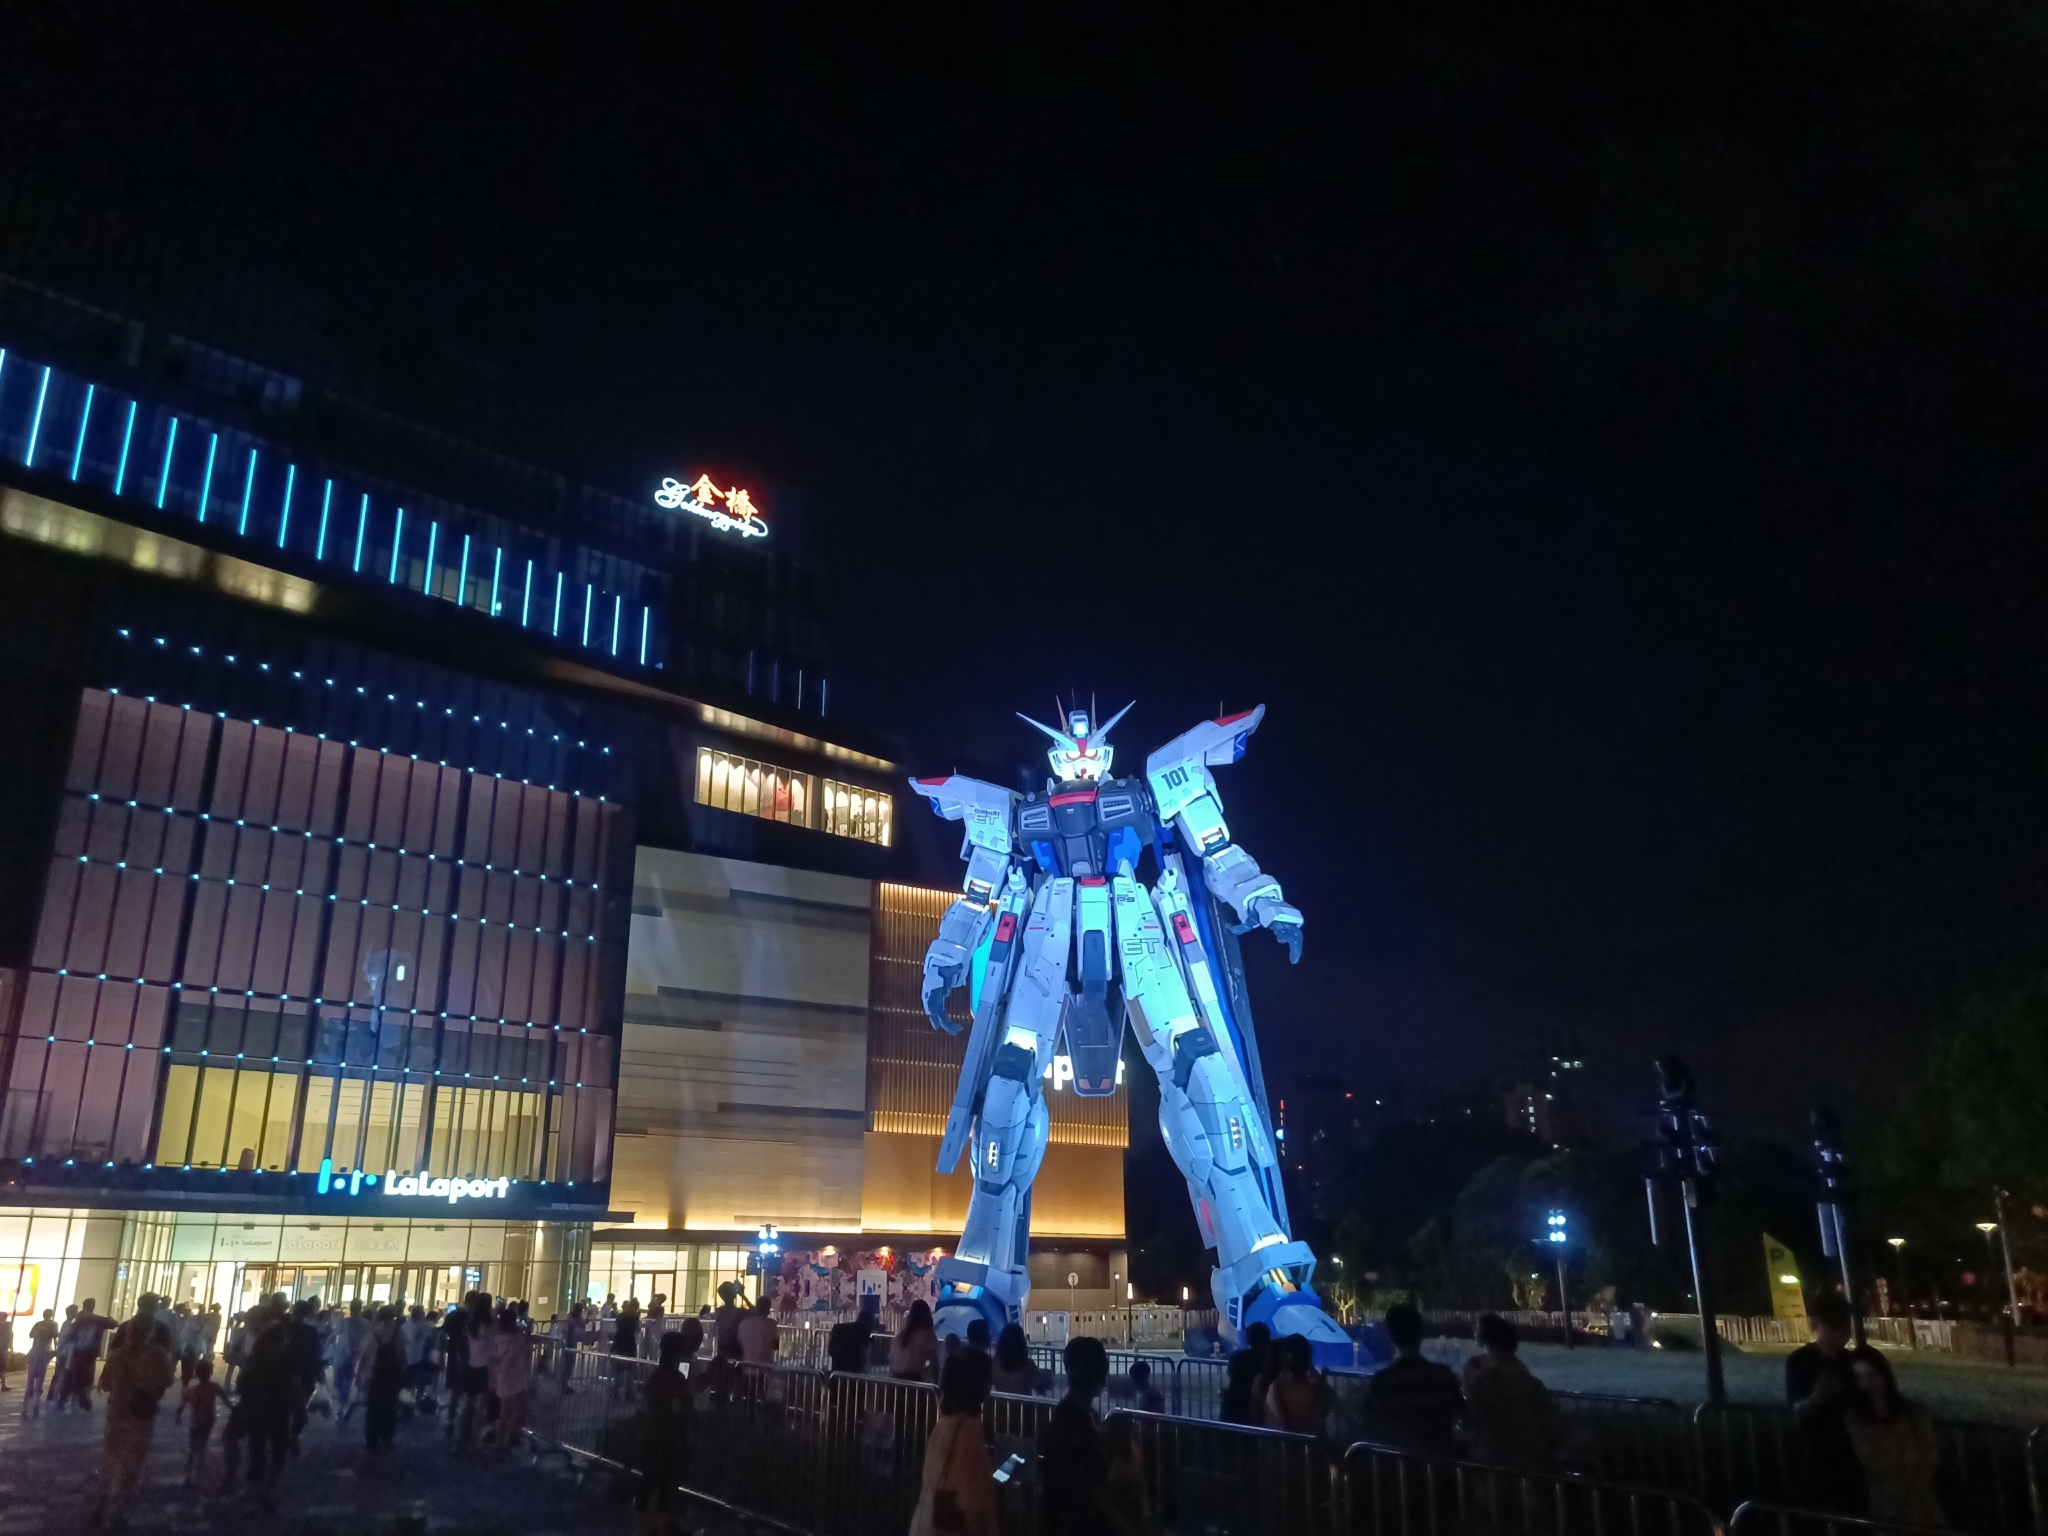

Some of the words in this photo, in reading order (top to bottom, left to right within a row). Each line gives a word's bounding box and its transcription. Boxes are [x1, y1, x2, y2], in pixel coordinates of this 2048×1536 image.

[1161, 766, 1189, 790] 101
[1121, 938, 1159, 955] ET
[384, 1170, 509, 1204] LaLaport
